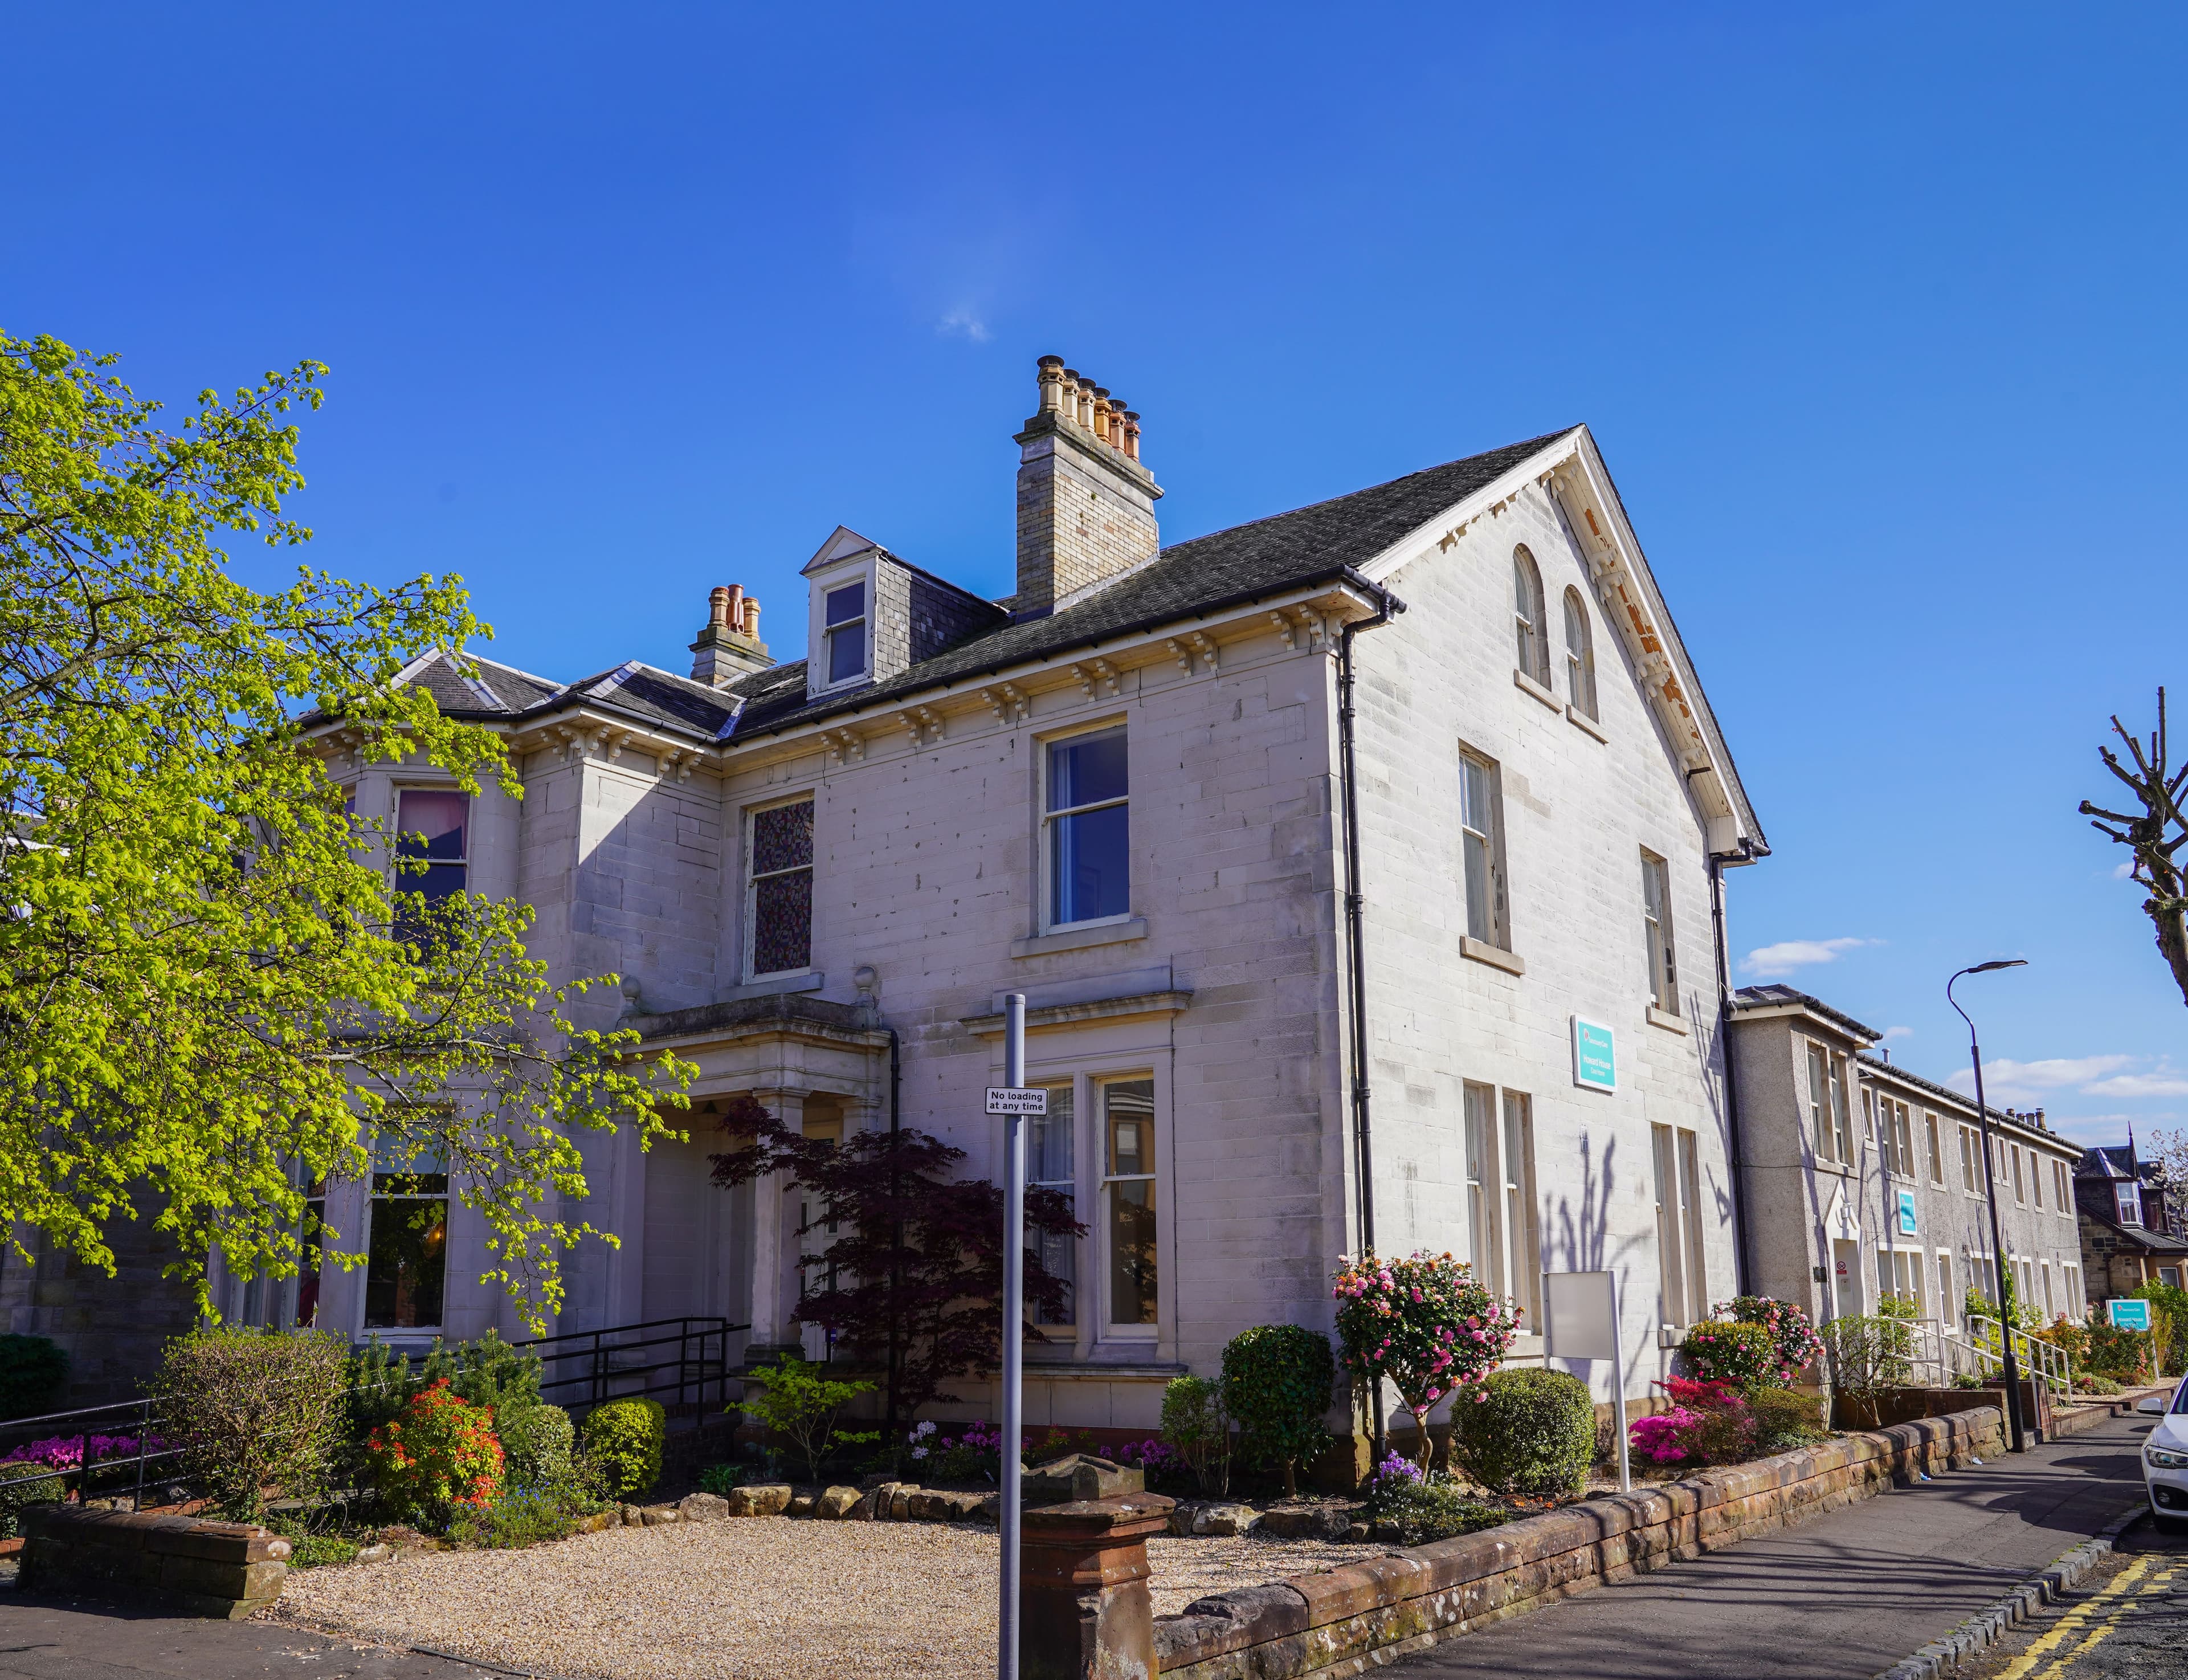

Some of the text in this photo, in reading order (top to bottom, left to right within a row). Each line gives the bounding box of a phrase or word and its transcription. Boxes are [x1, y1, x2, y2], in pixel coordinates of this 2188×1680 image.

[1583, 1054, 1611, 1070] Howard House
[1008, 1092, 1042, 1102] loading
